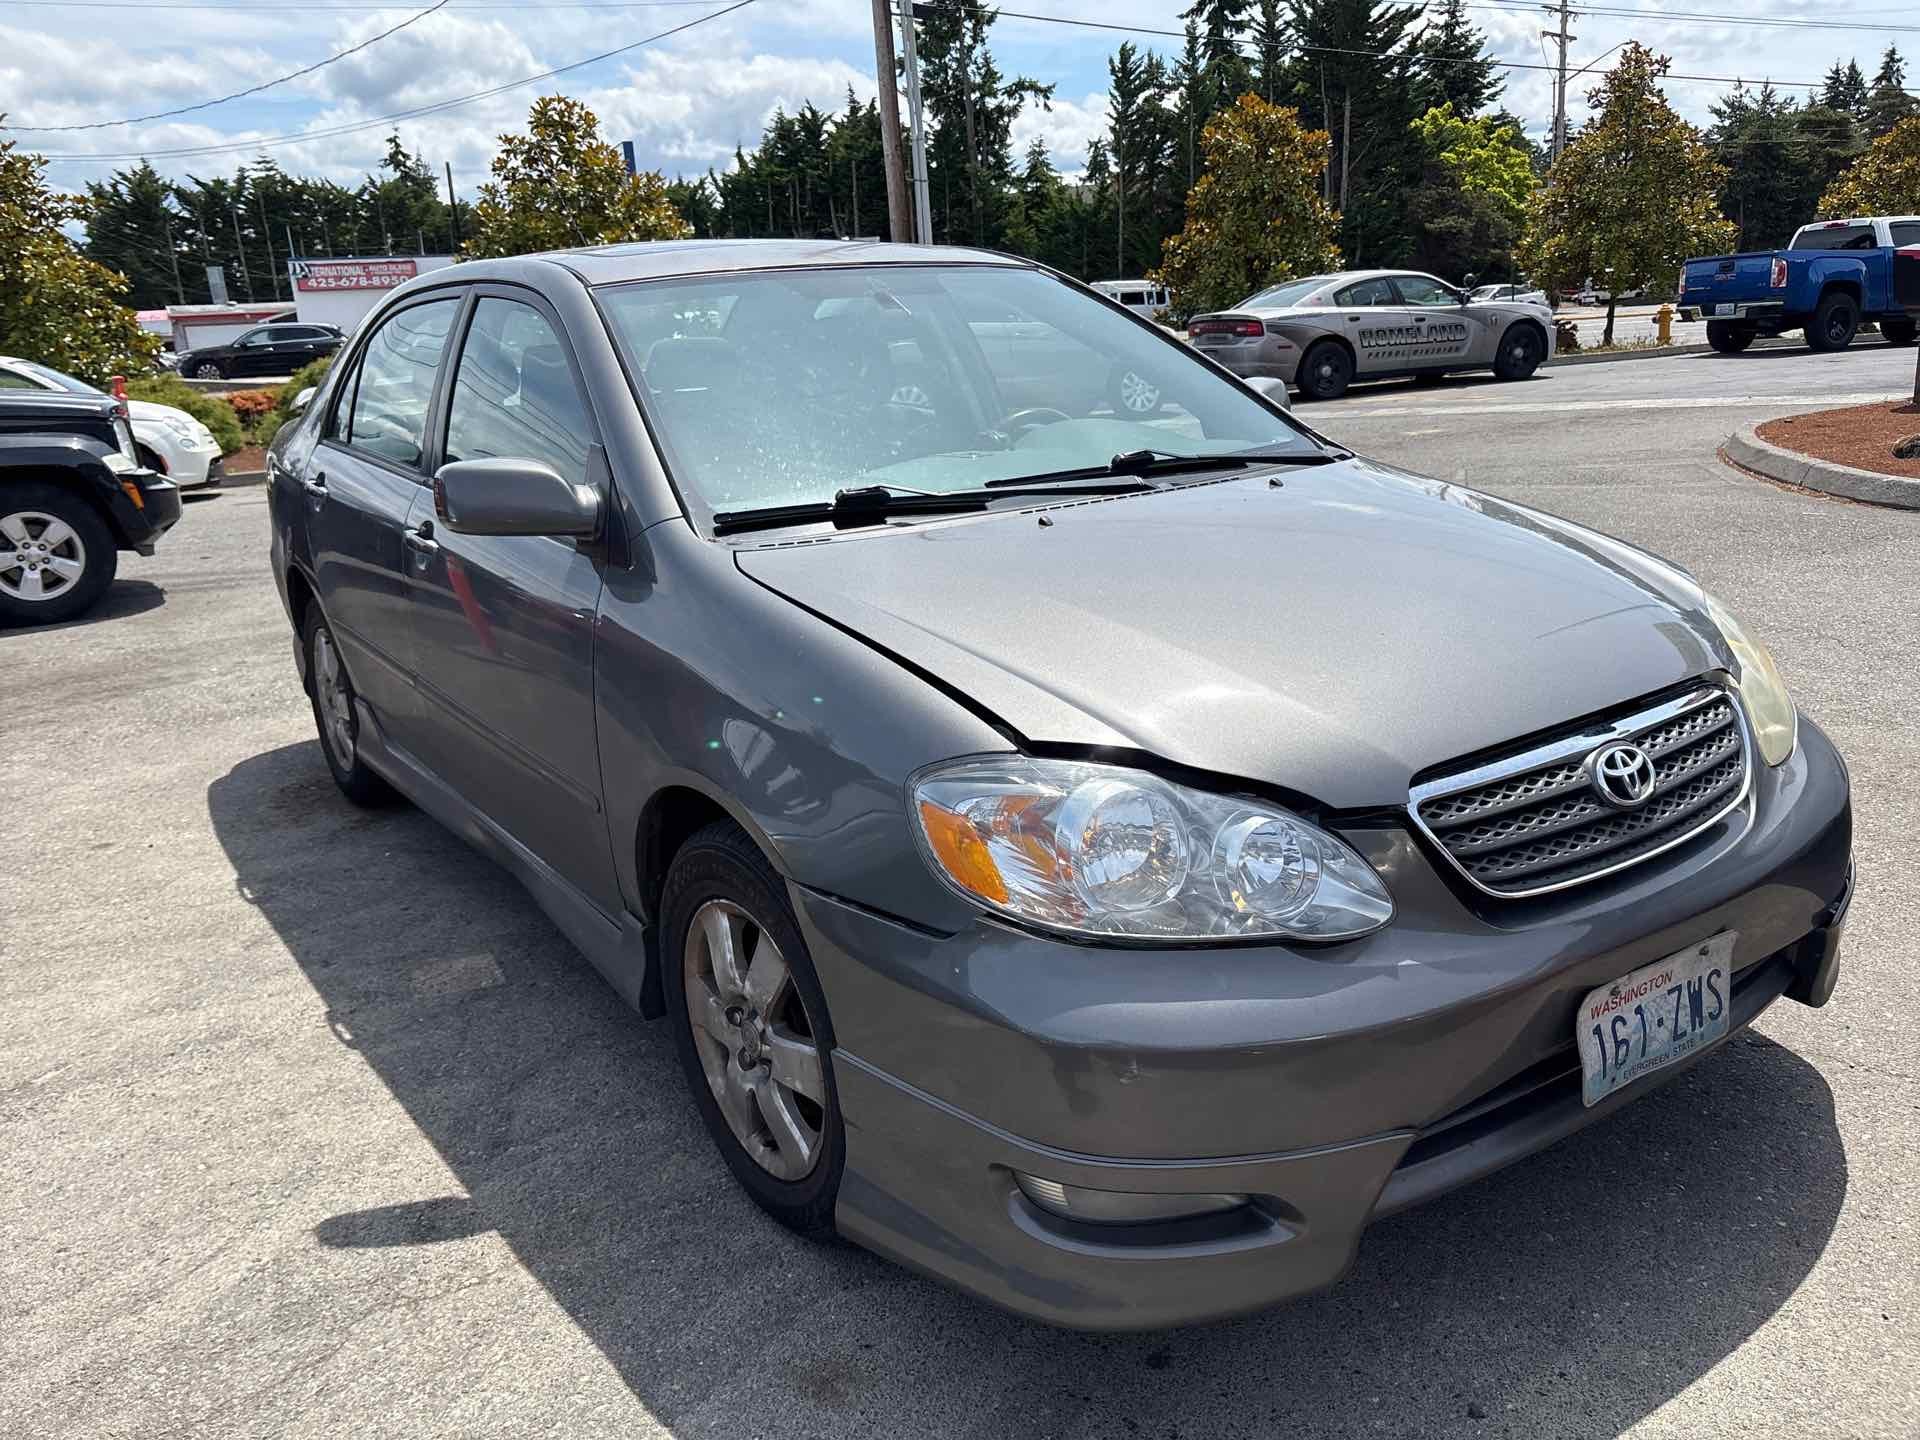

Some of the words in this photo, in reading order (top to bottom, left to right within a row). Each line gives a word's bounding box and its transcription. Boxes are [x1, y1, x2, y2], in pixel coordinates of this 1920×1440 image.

[310, 264, 366, 277] TERNATIONAL
[1359, 324, 1466, 348] HOMELAND
[1590, 970, 1673, 1020] WASHINGTON
[1623, 1054, 1670, 1081] EVERGREEN
[1673, 1039, 1695, 1057] STATE
